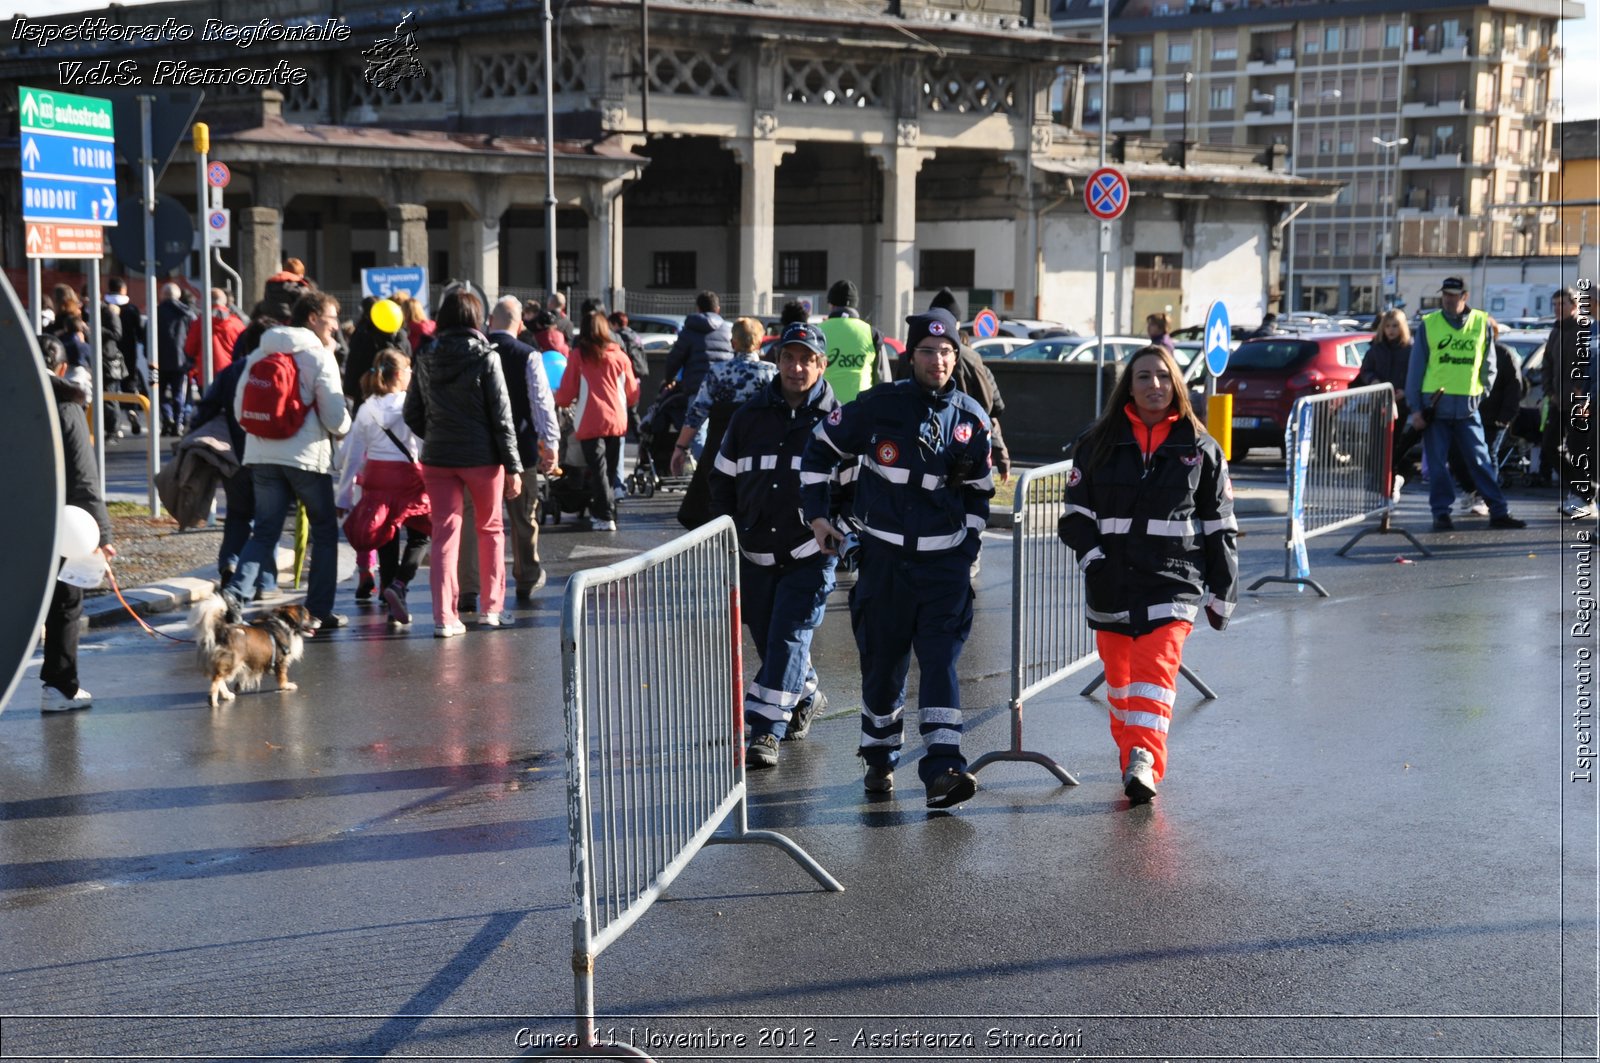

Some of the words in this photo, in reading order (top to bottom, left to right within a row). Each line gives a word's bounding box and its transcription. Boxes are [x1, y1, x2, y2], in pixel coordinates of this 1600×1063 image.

[54, 104, 111, 130] autostrada
[71, 145, 113, 171] TORINO
[379, 283, 392, 298] 5
[1451, 339, 1474, 351] asics
